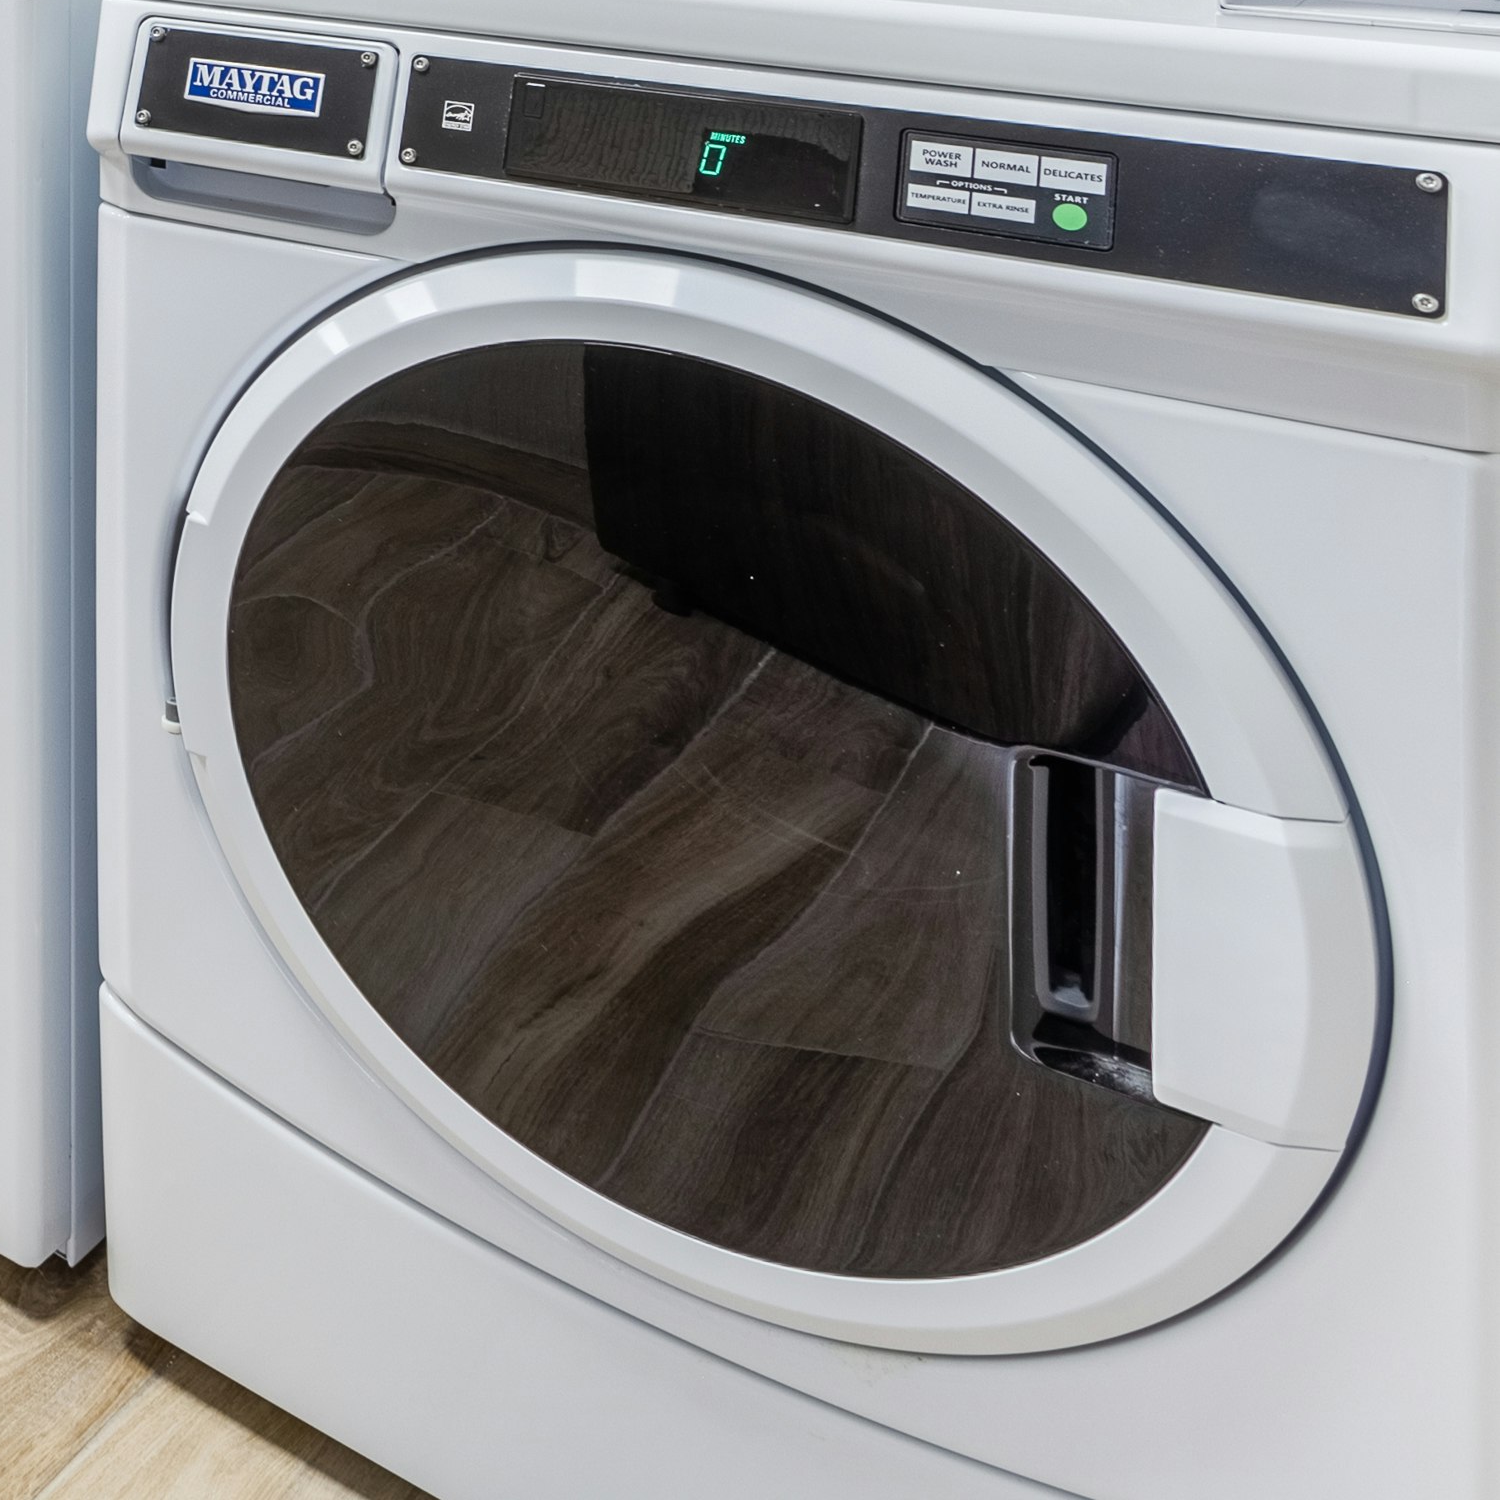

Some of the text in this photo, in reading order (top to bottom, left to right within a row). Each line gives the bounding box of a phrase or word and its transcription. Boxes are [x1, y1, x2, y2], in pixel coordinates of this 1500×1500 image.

[192, 64, 315, 101] MAYTAG
[209, 88, 291, 108] COMMERCIAL
[710, 131, 746, 144] MINUTES
[699, 143, 727, 176] 0
[922, 149, 962, 161] POWER
[925, 157, 958, 168] WASH
[981, 160, 1031, 174] NORMAL
[1043, 168, 1103, 183] DELICATES
[951, 180, 993, 192] OPTIONS
[910, 192, 967, 205] TEMPERATURE
[1053, 193, 1089, 205] START
[977, 201, 1030, 214] EXTRA RINSE
